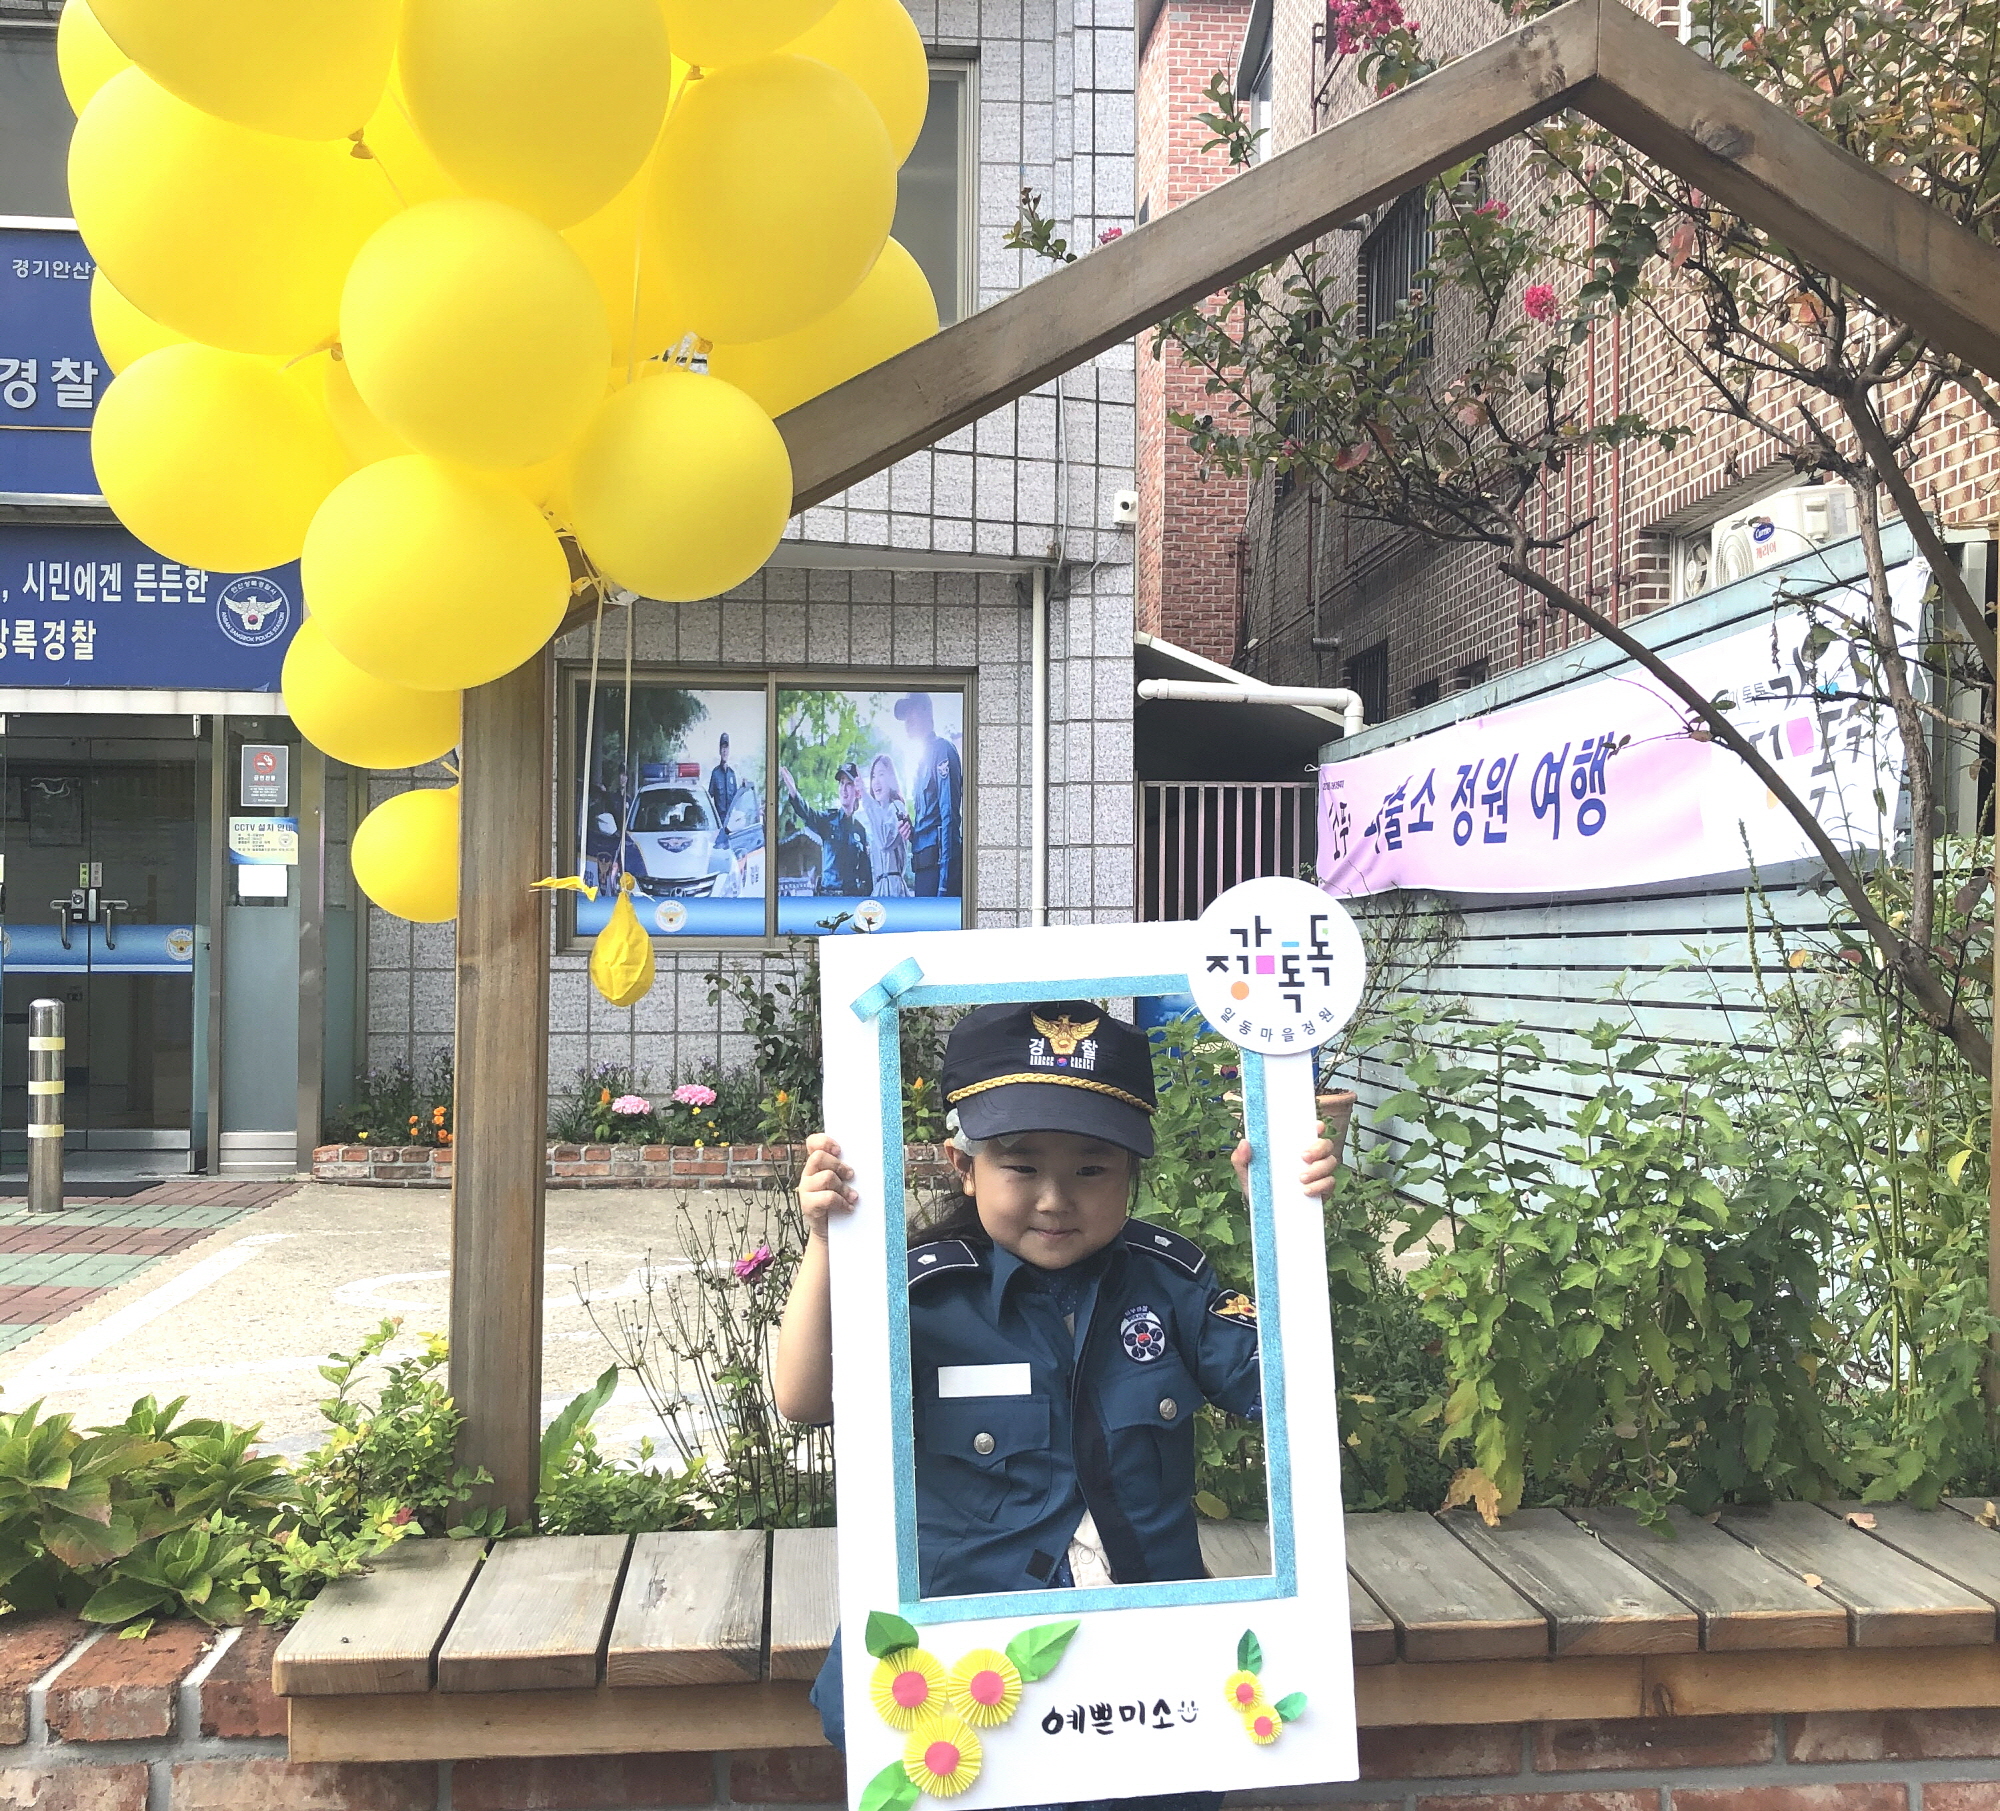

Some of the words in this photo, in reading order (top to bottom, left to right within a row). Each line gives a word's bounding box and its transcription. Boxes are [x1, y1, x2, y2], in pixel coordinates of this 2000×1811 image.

[12, 259, 96, 280] 경기안산
[22, 561, 122, 602] 시민에겐
[133, 563, 209, 603] 든든한
[1451, 758, 1520, 847] 정원
[1531, 731, 1615, 840] 여행
[234, 823, 255, 832] CCTV
[258, 823, 274, 832] 설치
[277, 823, 294, 832] 안내
